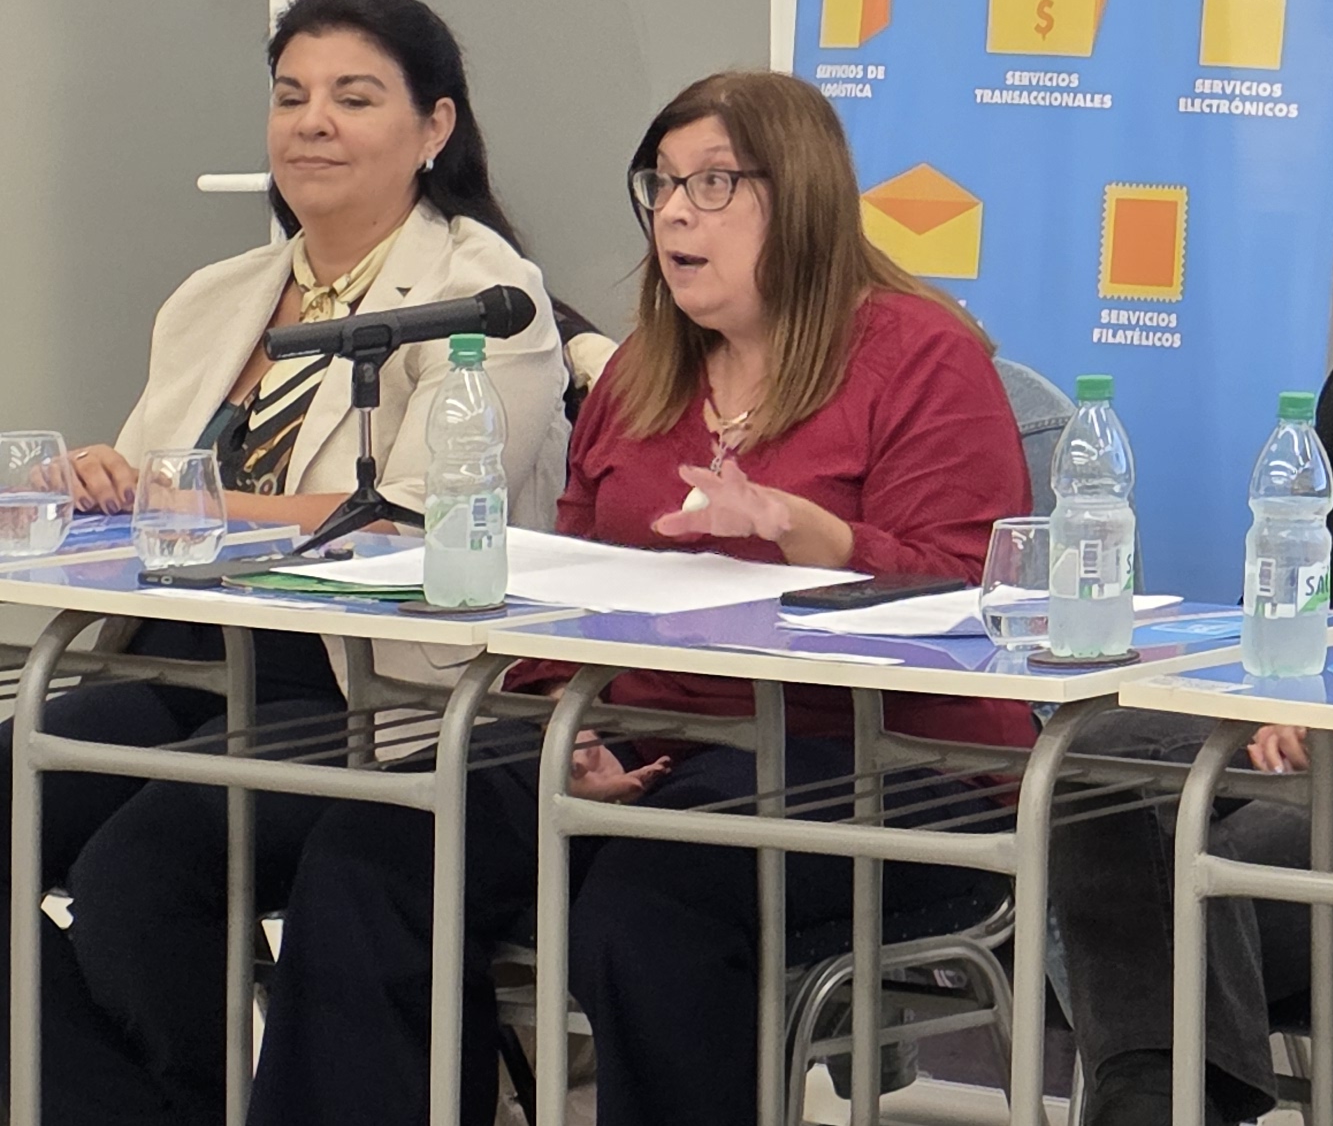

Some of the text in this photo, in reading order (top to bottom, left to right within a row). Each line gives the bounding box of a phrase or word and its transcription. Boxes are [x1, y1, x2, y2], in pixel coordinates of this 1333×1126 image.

[867, 65, 885, 79] DE
[1005, 70, 1080, 88] SERVICIOS
[1194, 78, 1282, 98] SERVICIOS
[975, 89, 1113, 109] TRANSACCIONALES
[1178, 95, 1299, 118] ELECTRÓNICOS
[1100, 309, 1178, 328] SERVICIOS
[1092, 327, 1182, 348] FILATÉLICOS
